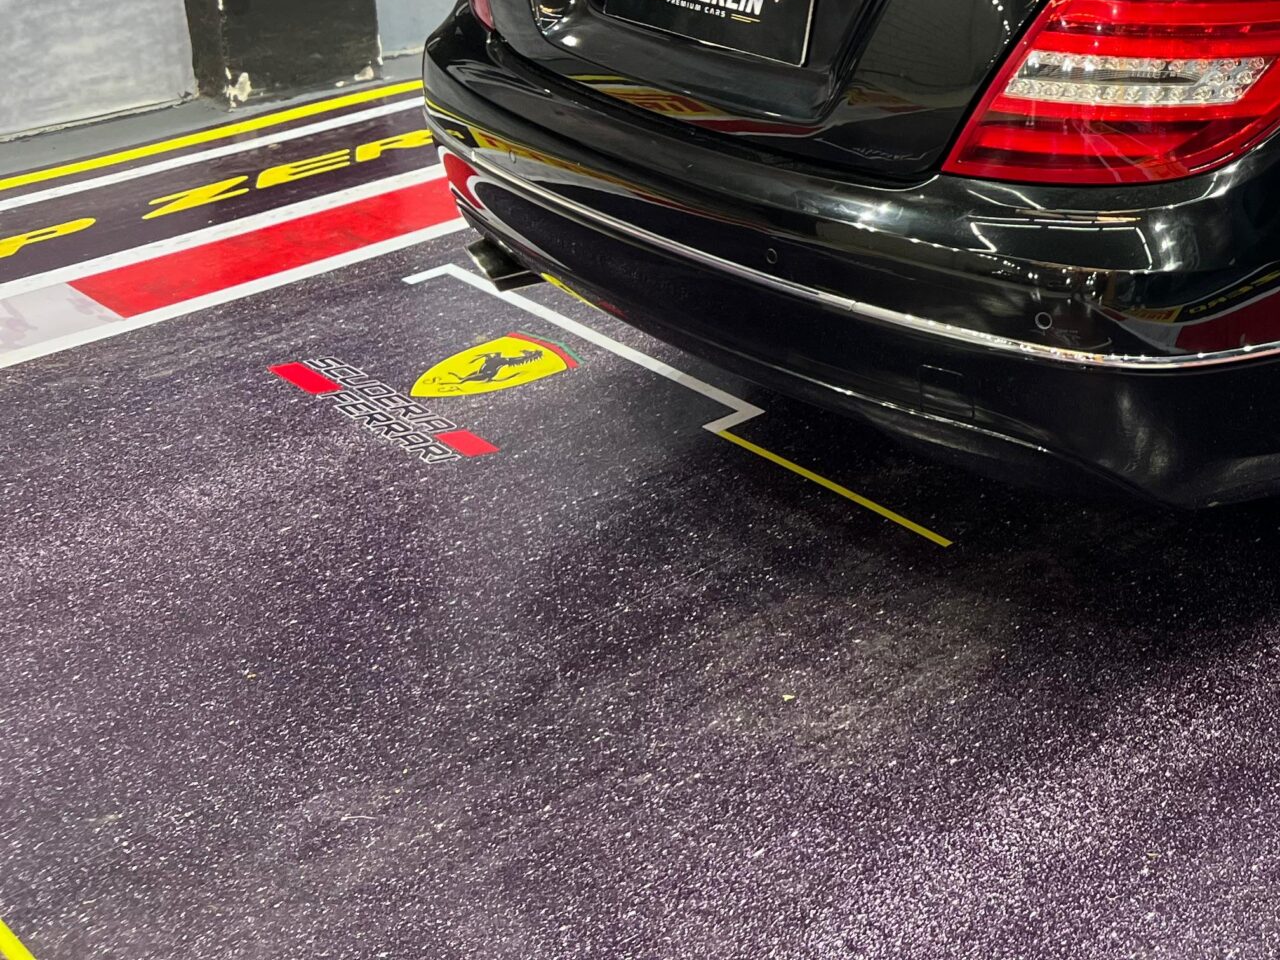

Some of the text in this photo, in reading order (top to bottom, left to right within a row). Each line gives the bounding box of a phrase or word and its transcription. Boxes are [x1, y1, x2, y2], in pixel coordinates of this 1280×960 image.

[704, 6, 726, 17] CARS
[141, 129, 434, 220] ZER
[302, 355, 458, 434] SCUDERIA
[315, 390, 463, 464] FERRARI
